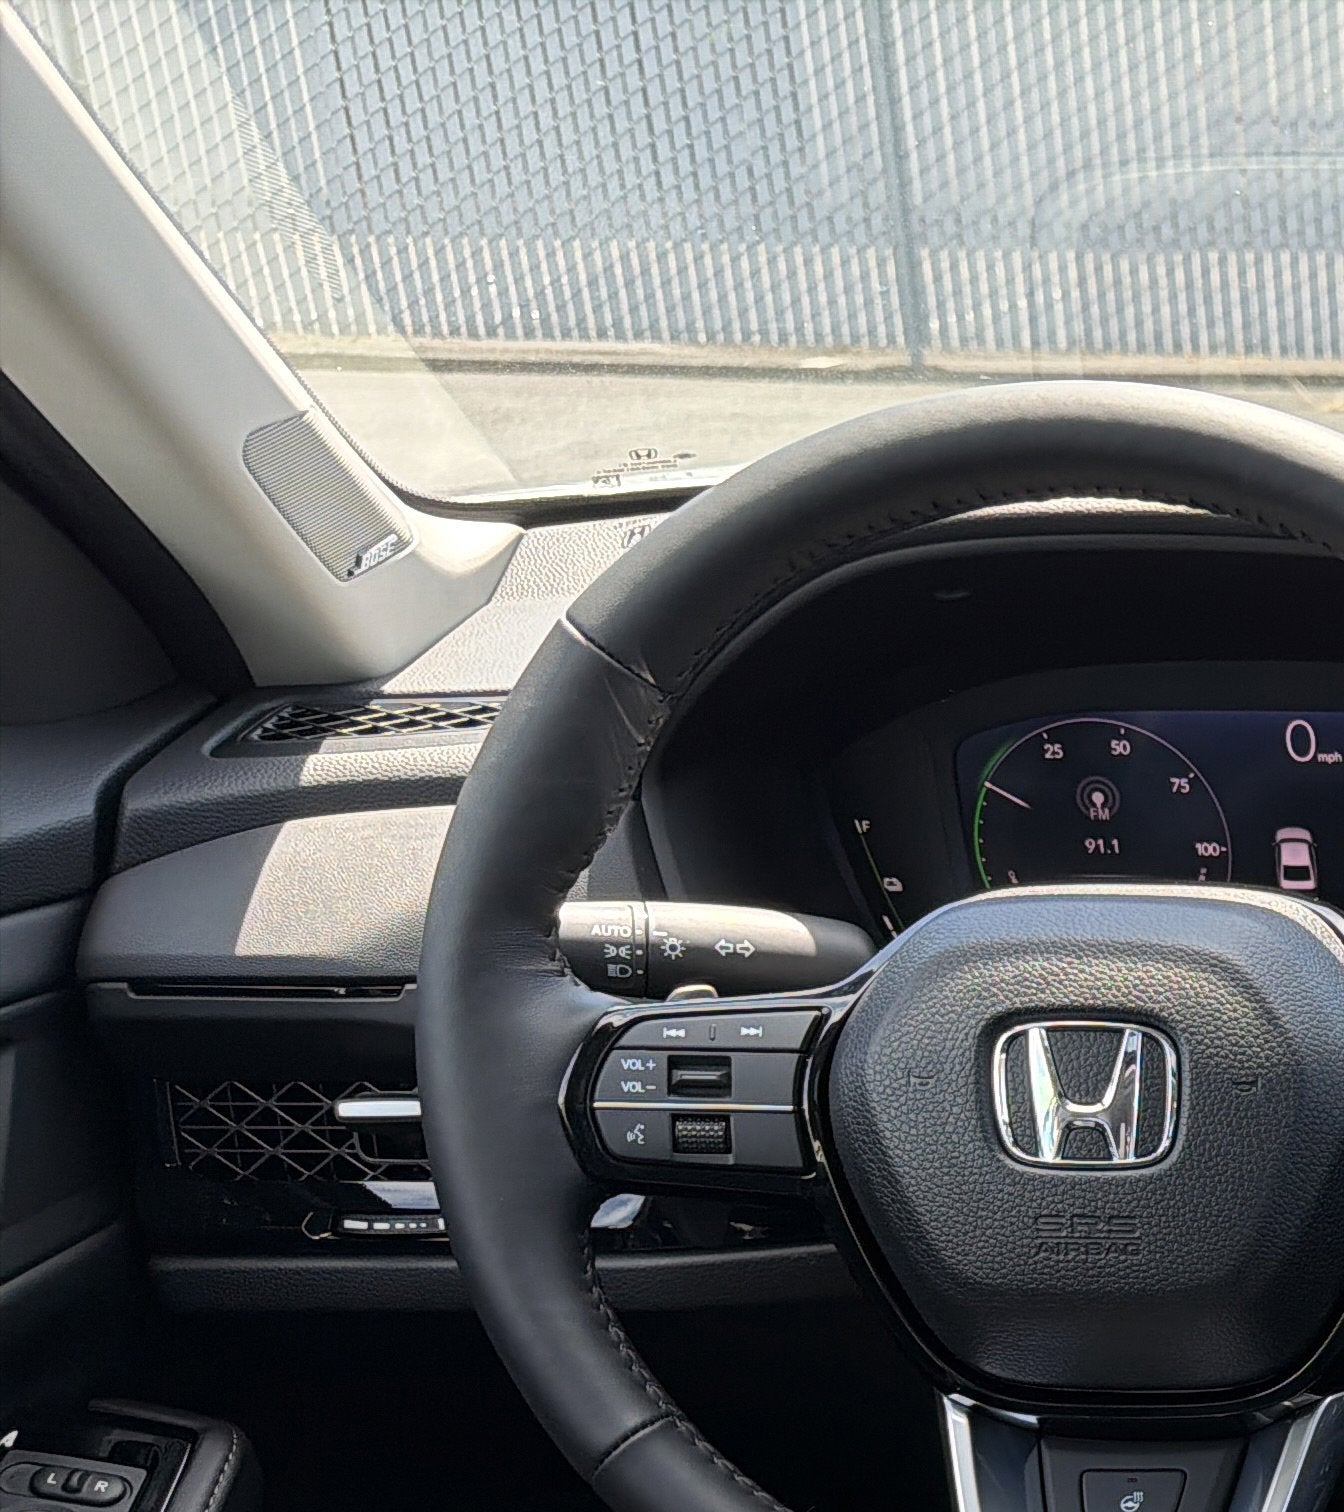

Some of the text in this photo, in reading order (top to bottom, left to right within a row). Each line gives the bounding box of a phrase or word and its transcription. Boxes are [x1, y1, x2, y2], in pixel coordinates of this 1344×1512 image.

[360, 540, 397, 570] BOSE
[1111, 741, 1130, 756] 50
[1286, 720, 1343, 763] 0 mph
[1044, 744, 1064, 759] 25
[1170, 778, 1190, 794] 75
[1090, 808, 1110, 821] FM
[1084, 839, 1119, 854] 91.1
[1195, 842, 1220, 857] 100
[591, 924, 632, 937] AUTO
[1036, 1215, 1140, 1237] SRS
[47, 1473, 109, 1492] L R
